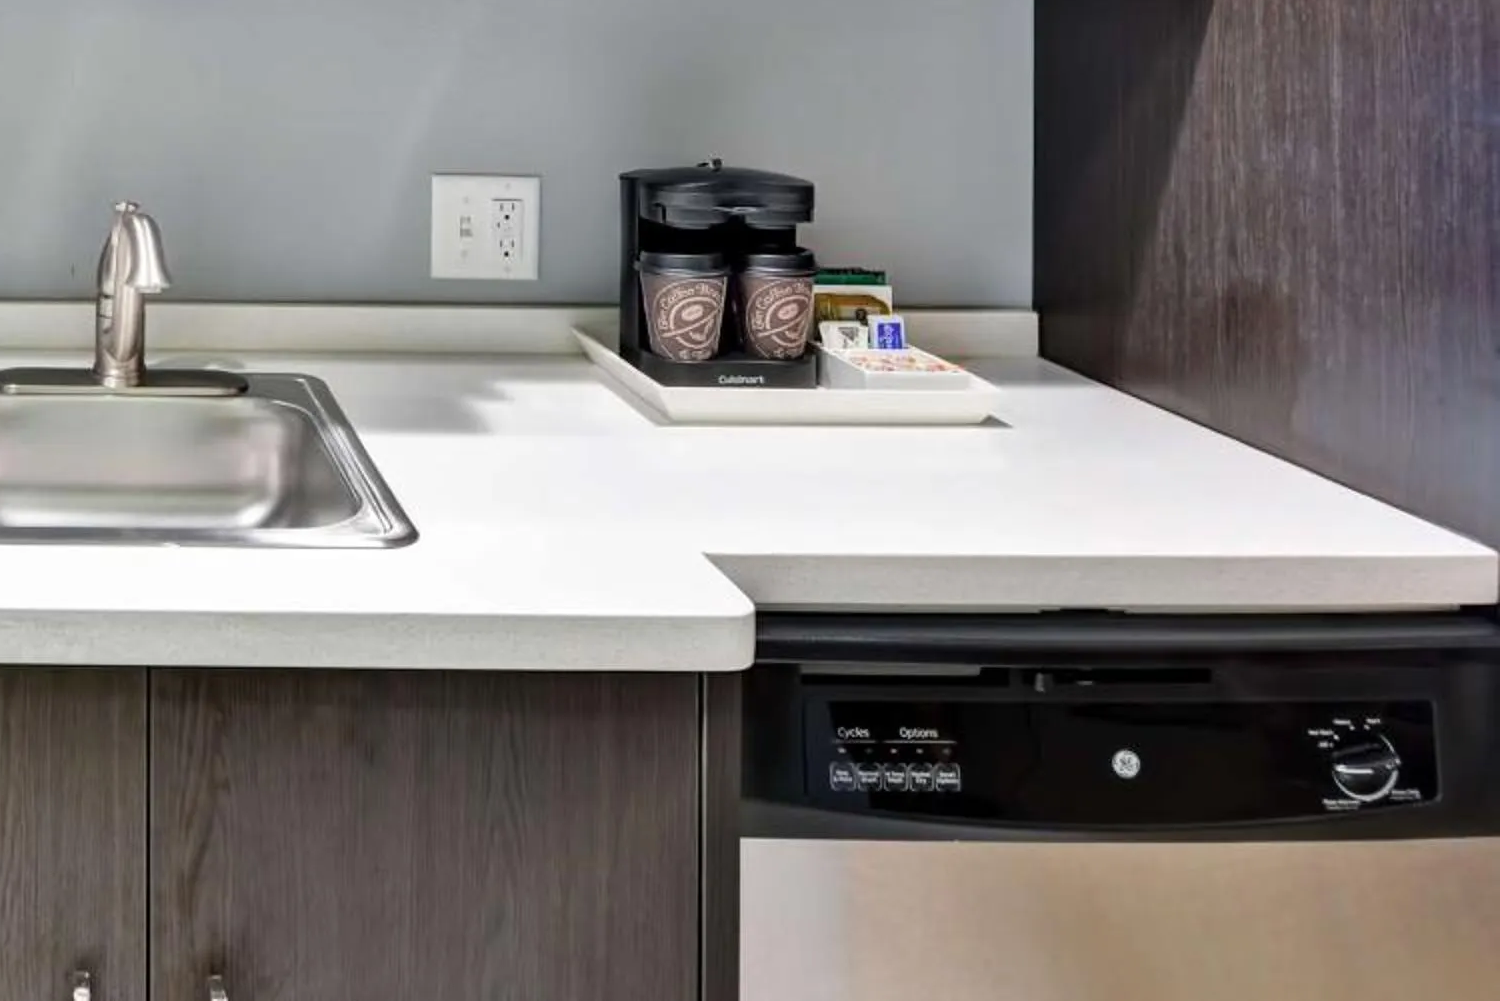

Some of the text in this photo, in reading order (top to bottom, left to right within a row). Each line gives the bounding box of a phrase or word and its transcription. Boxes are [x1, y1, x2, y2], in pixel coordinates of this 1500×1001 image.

[718, 374, 765, 385] Cuisinart
[836, 726, 871, 739] Cycles
[899, 726, 940, 740] Options
